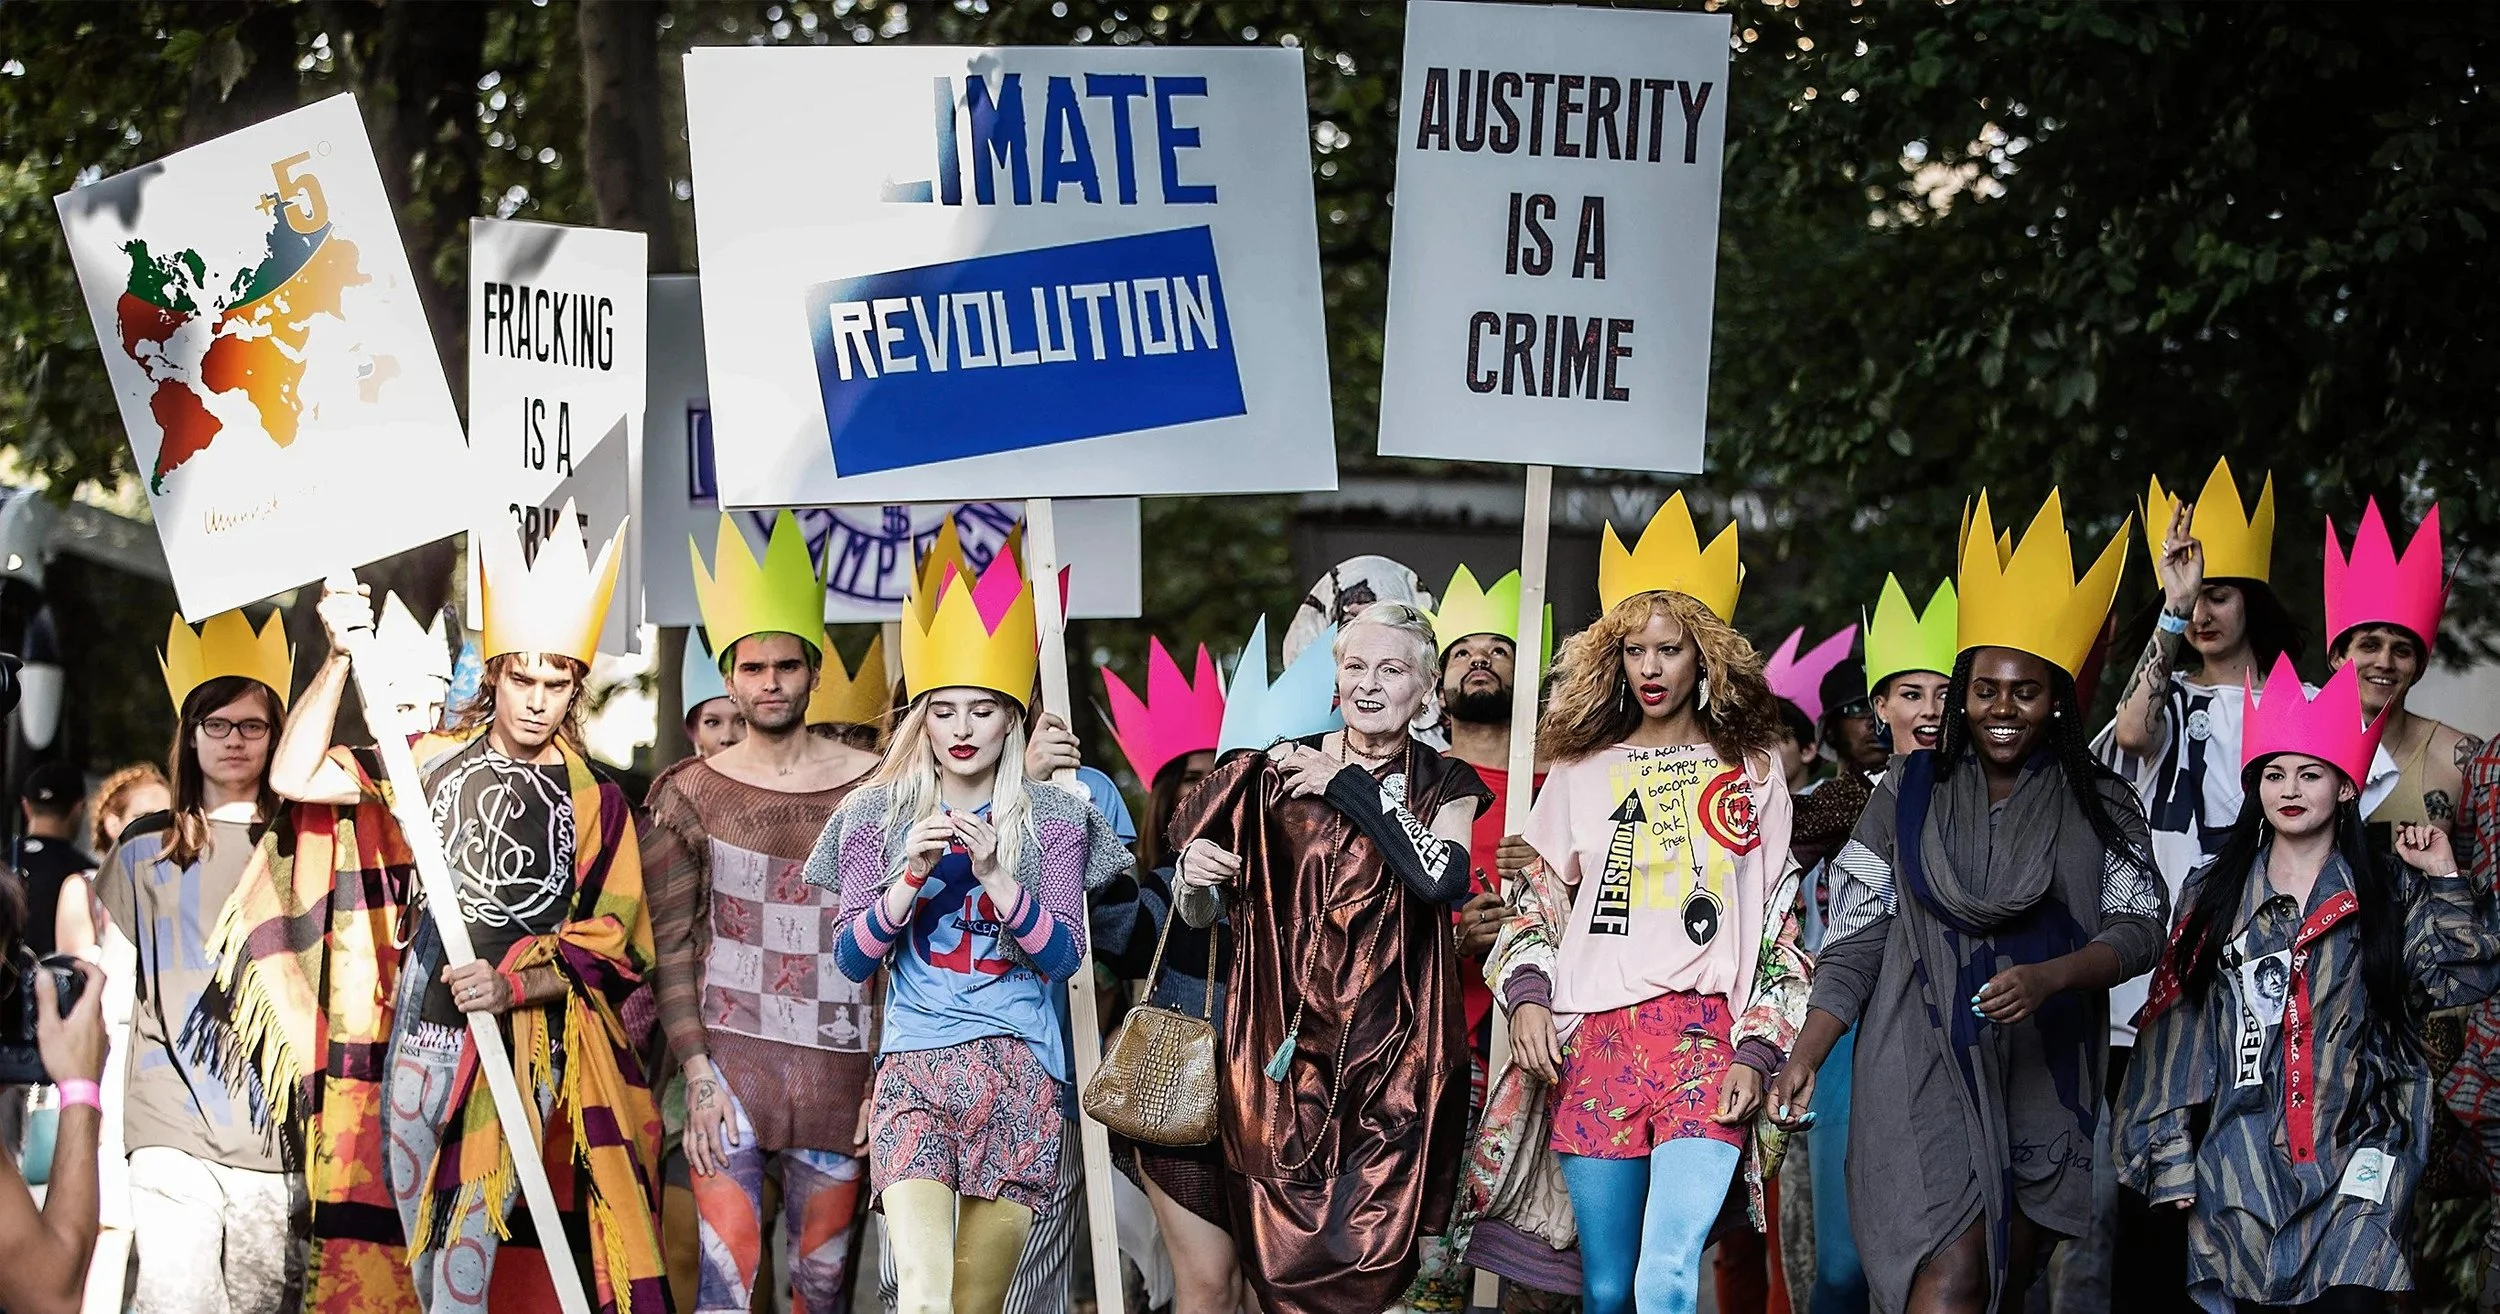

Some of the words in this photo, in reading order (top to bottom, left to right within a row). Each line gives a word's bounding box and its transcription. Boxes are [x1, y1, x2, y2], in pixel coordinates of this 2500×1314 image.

[879, 72, 1218, 207] IMATE
[1416, 67, 1713, 164] AUSTERITY
[1505, 192, 1556, 277] IS
[1572, 196, 1606, 280] A
[484, 281, 613, 371] FRACKING
[829, 274, 1218, 381] REVOLUTION
[1466, 311, 1634, 402] CRIME
[524, 397, 546, 471] IS
[557, 402, 574, 478] A
[1641, 765, 1653, 777] is
[1648, 775, 1700, 798] become
[1592, 821, 1636, 935] YOURSELF
